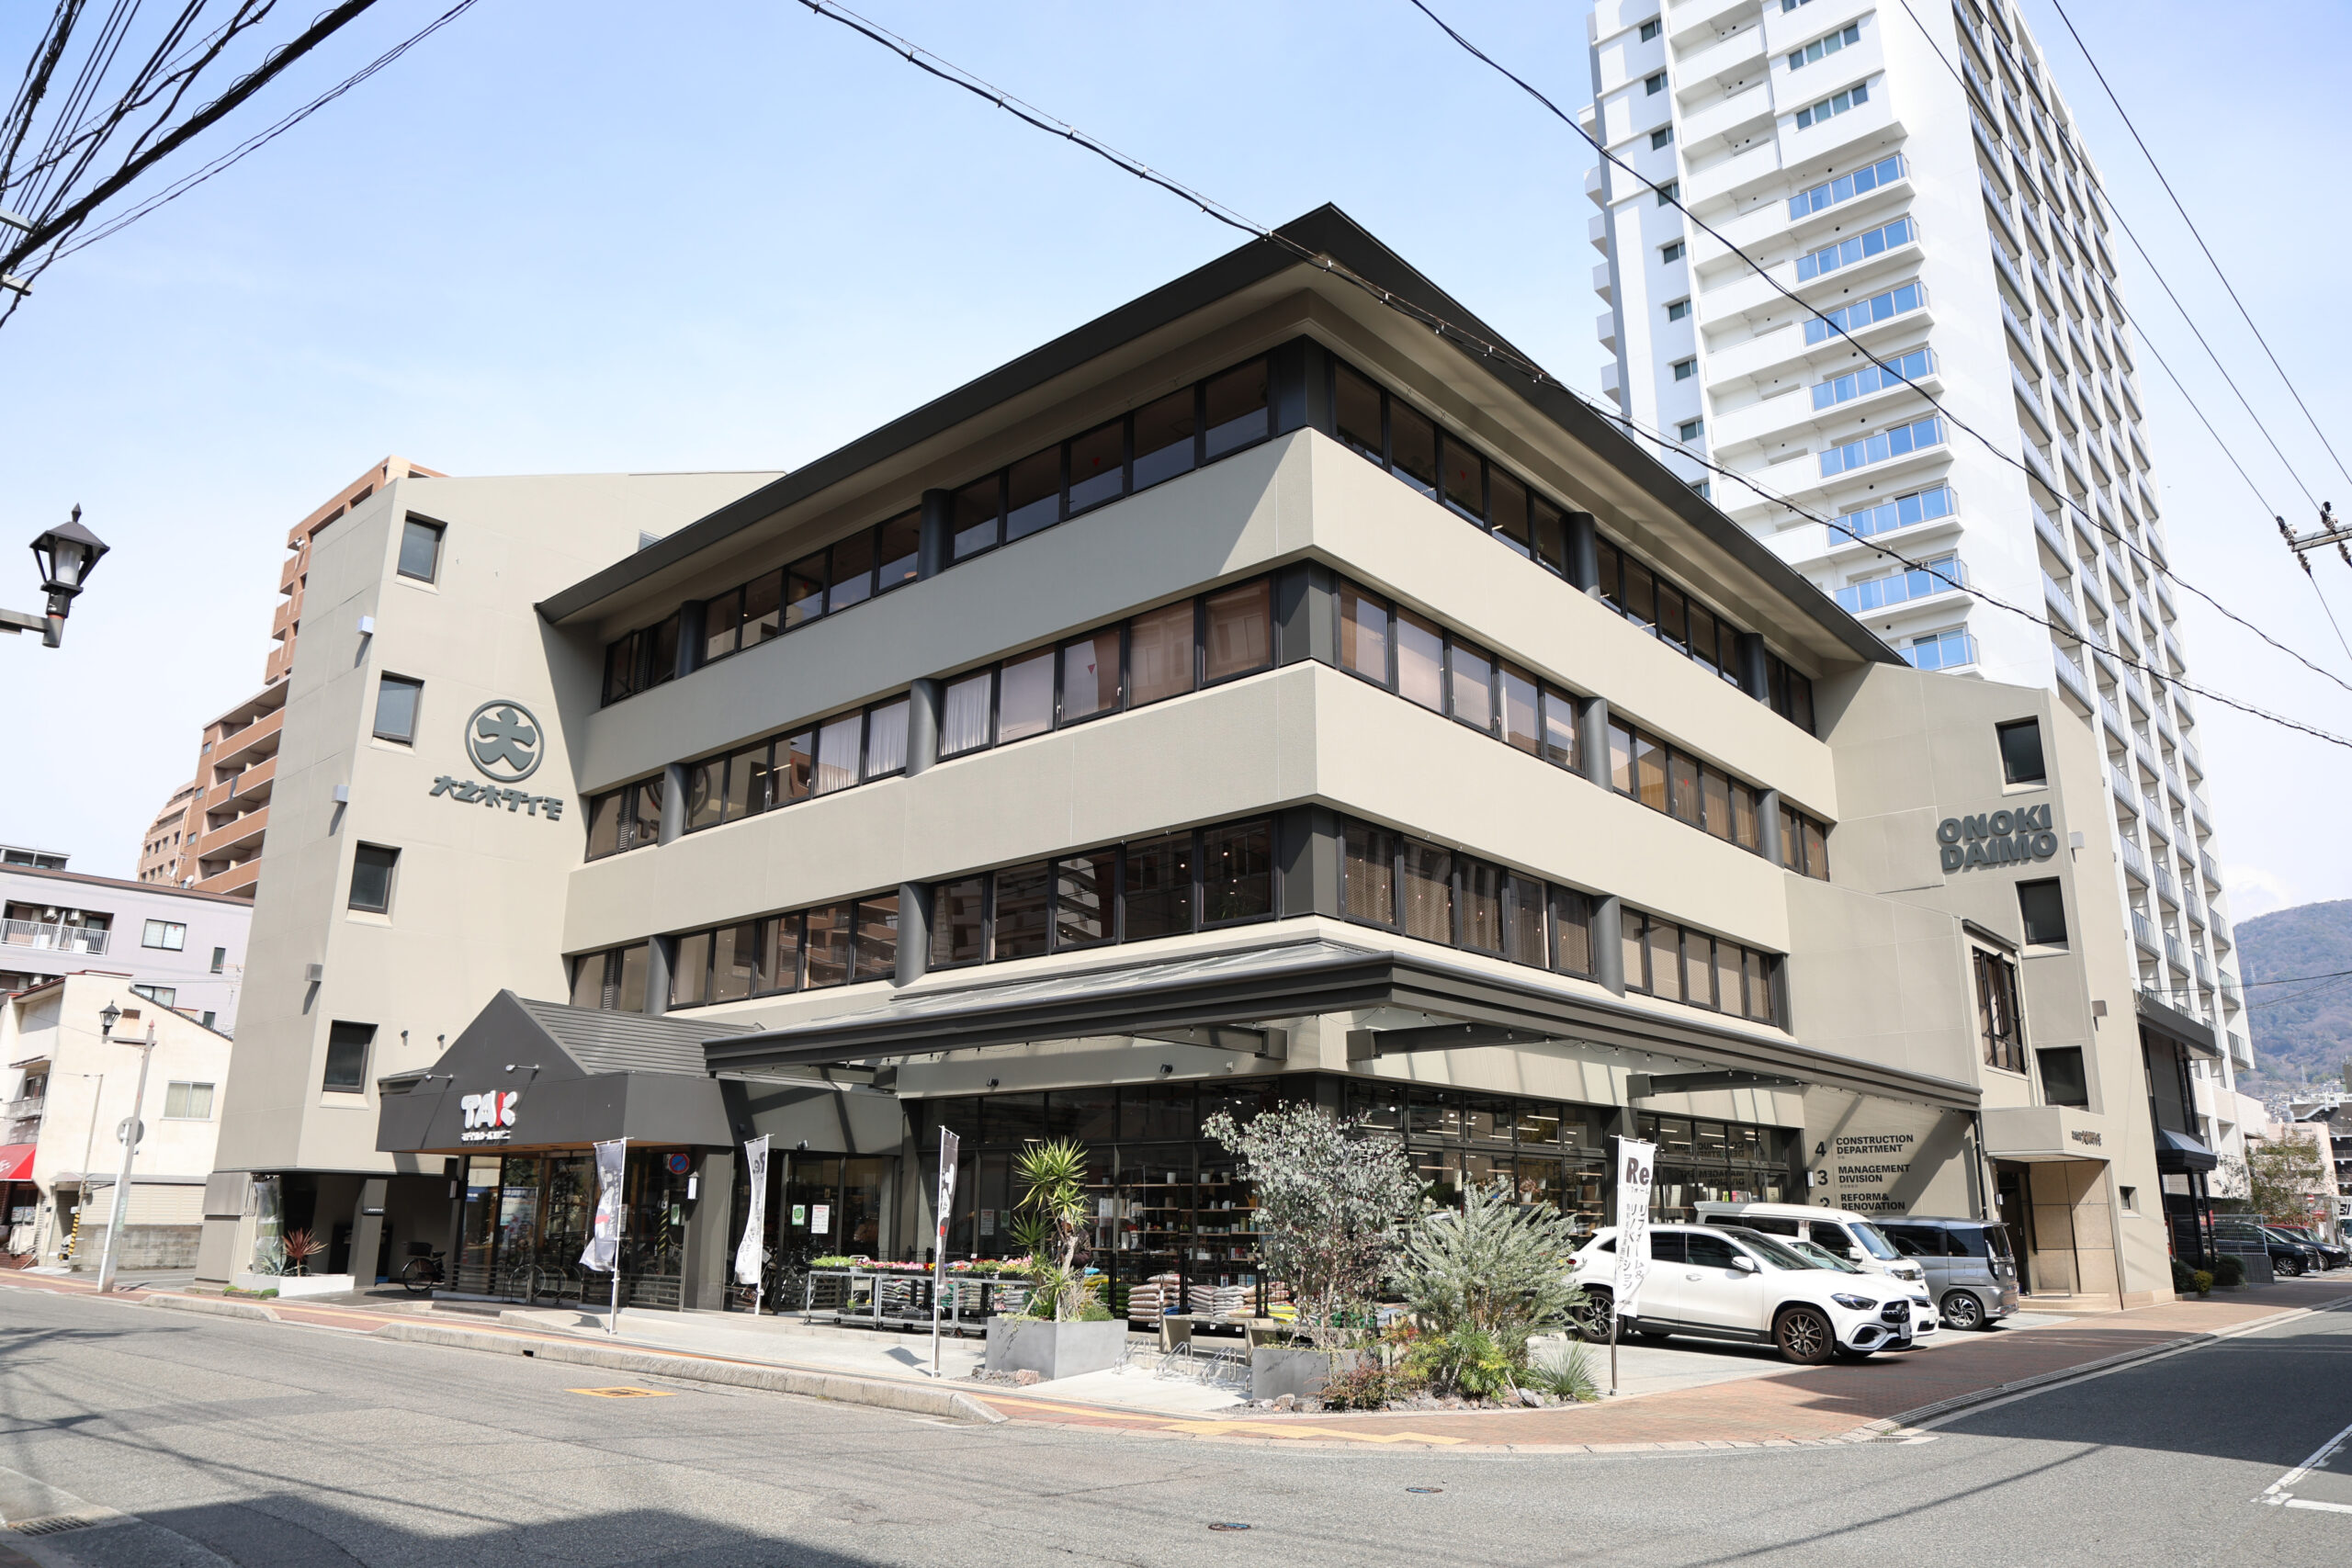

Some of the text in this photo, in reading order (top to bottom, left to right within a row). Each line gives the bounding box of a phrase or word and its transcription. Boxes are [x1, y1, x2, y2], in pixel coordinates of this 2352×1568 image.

[428, 774, 564, 821] 大之木ダイモ
[1937, 803, 2053, 845] ONOKI
[1940, 831, 2058, 873] DAIMO
[460, 1089, 518, 1130] TAK
[1836, 1134, 1914, 1145] CONSTRUCTION
[1815, 1141, 1827, 1157] 4
[1837, 1144, 1904, 1155] DEPARTMENT
[1838, 1164, 1911, 1174] MANAGEMENT
[1817, 1169, 1828, 1186] 3
[1839, 1174, 1883, 1184] DIVISION
[1840, 1192, 1890, 1202] REFORM&
[1841, 1201, 1905, 1211] RENOVATION
